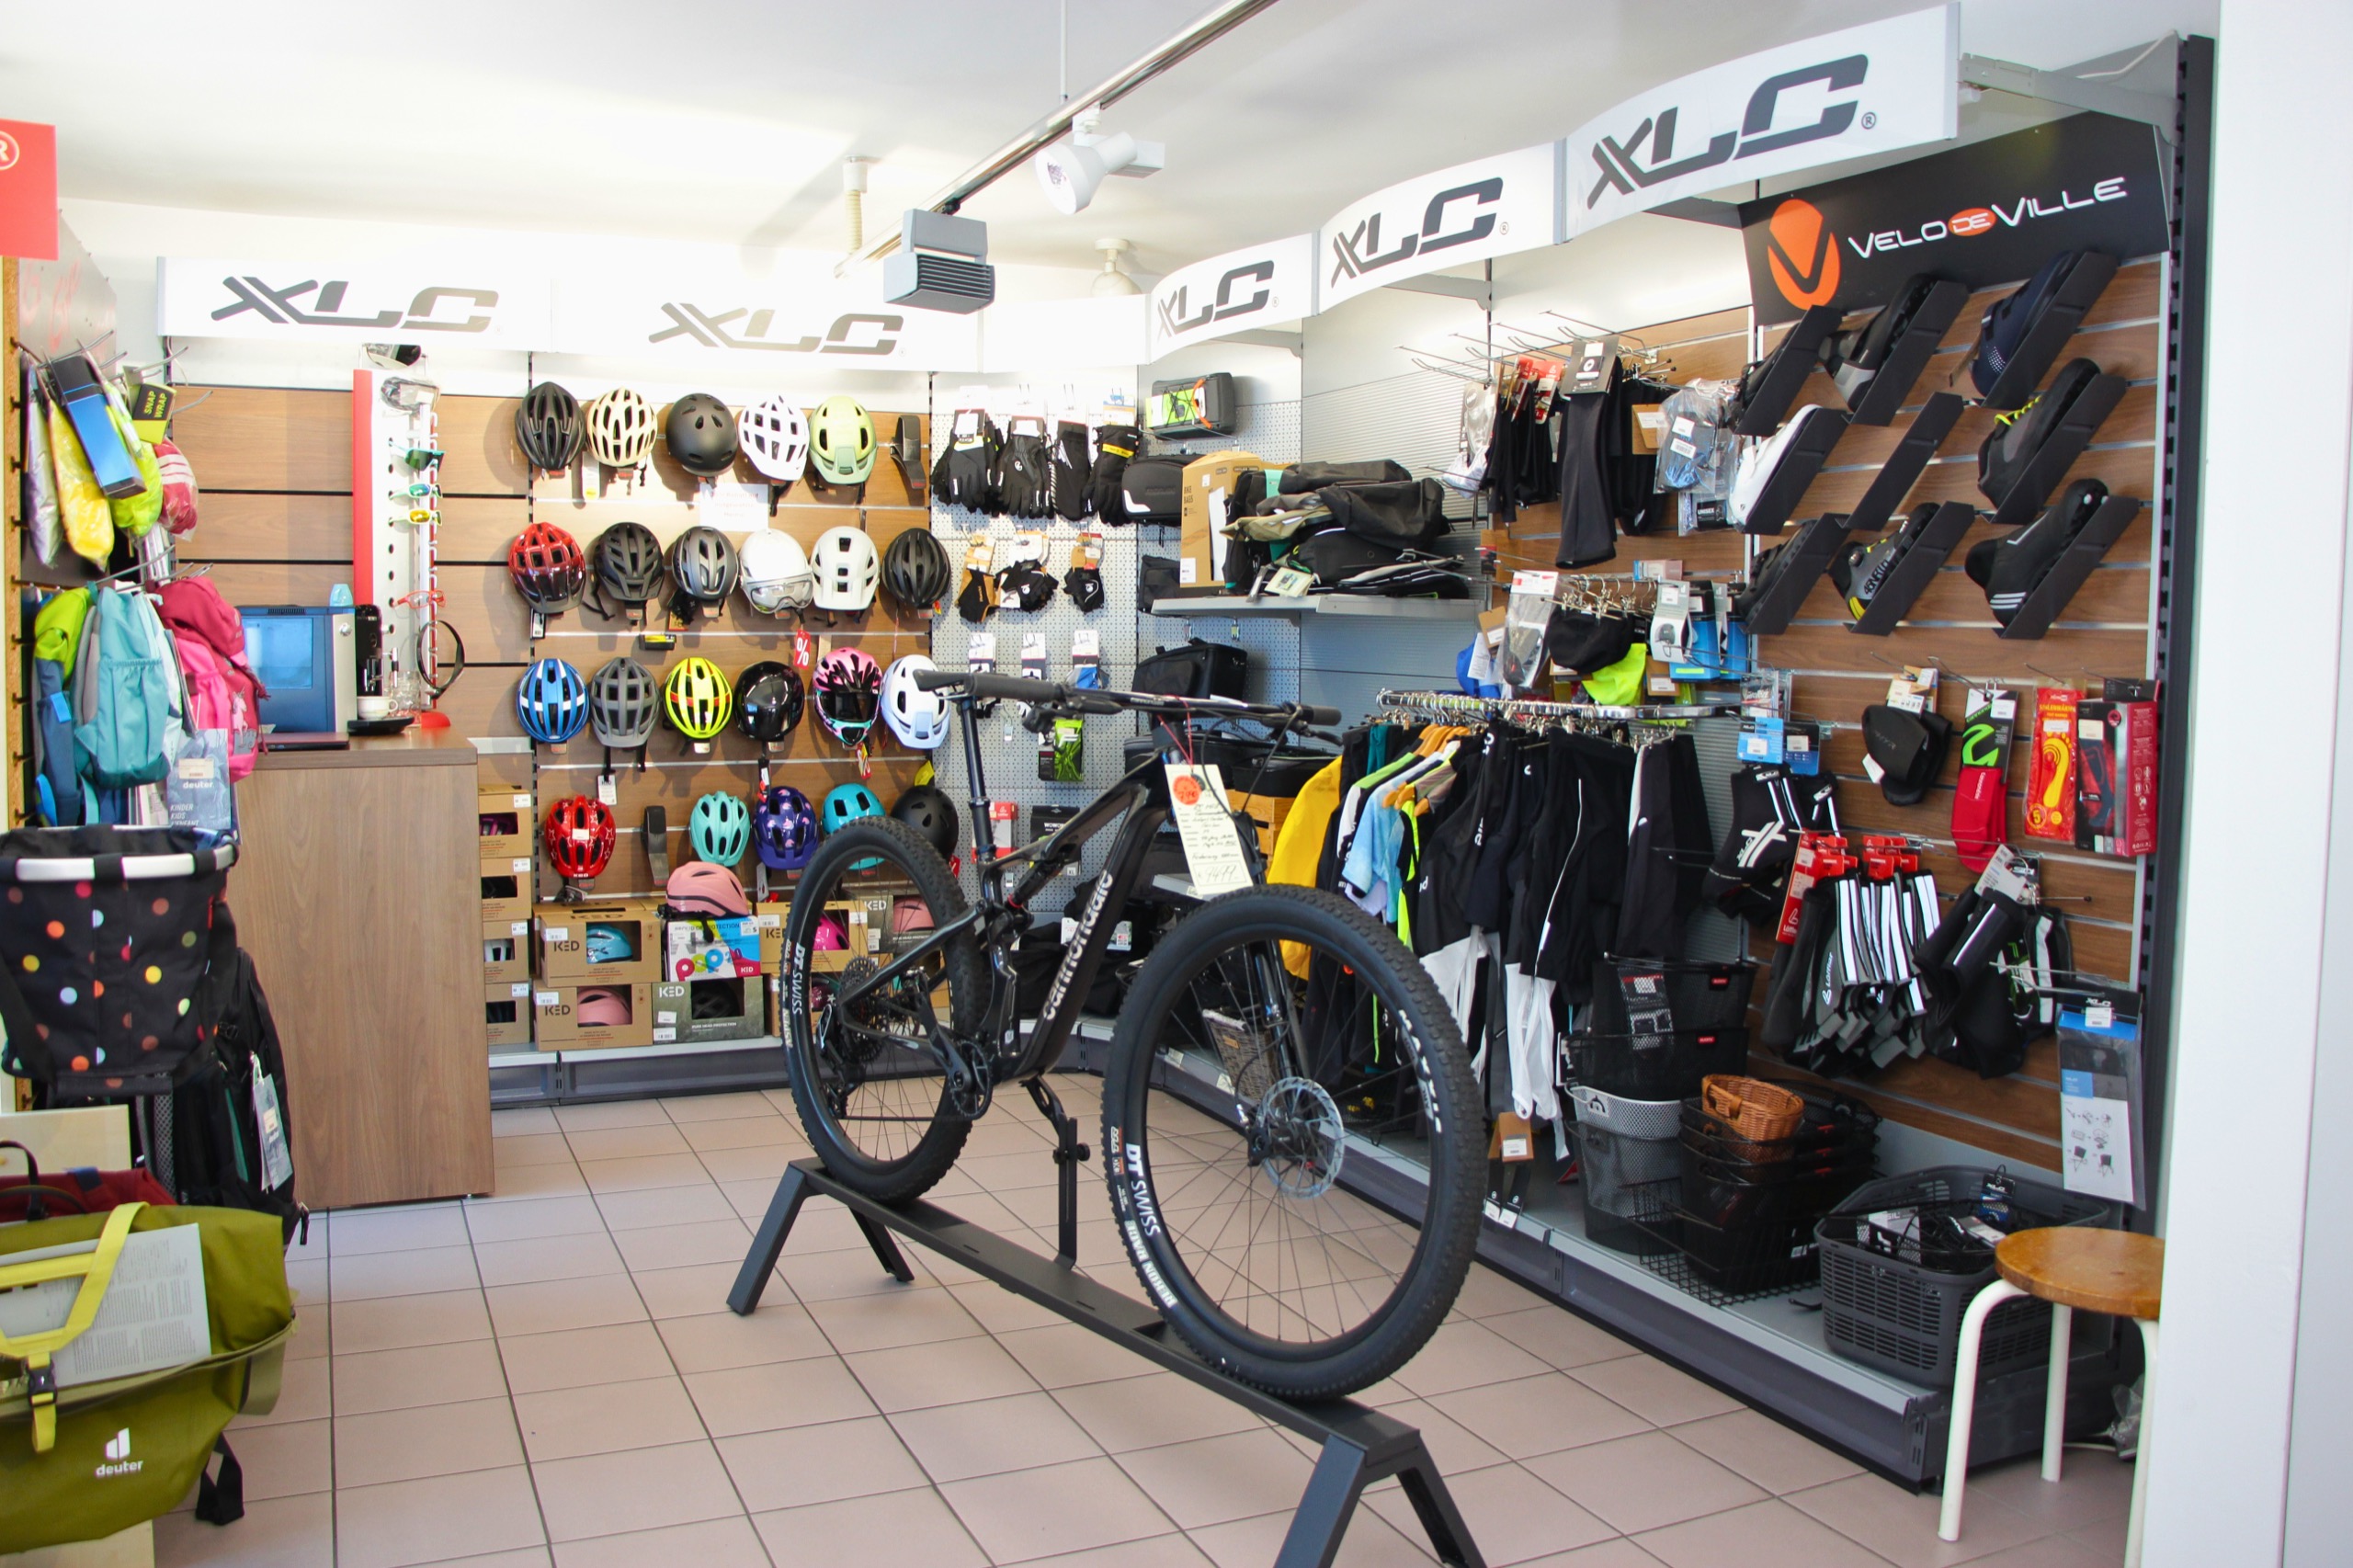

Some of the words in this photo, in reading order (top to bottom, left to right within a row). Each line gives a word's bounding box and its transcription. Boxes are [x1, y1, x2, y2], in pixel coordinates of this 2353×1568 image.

[1587, 53, 1870, 210] XLC
[1330, 176, 1505, 289] XLC
[210, 276, 500, 333] XLC
[1156, 259, 1275, 342] XLC
[648, 301, 904, 356] XLC
[143, 390, 156, 415] SNAP
[153, 392, 167, 418] WRAP
[1697, 507, 1715, 516] UNISEX
[183, 781, 213, 790] deuter
[170, 803, 194, 812] KINDER
[170, 812, 186, 821] KIDS
[863, 900, 887, 912] KED
[553, 940, 580, 952] KED
[793, 942, 806, 971] DT
[1042, 869, 1114, 1020] cannondale
[659, 985, 685, 998] KED
[791, 970, 803, 1016] SWISS
[2085, 996, 2112, 1008] XLC
[545, 1005, 572, 1016] KED
[1125, 1142, 1144, 1177] DT
[1131, 1179, 1161, 1237] SWISS
[1124, 1219, 1149, 1263] RACE
[1142, 1260, 1178, 1309] REKON
[95, 1460, 143, 1478] deuter
